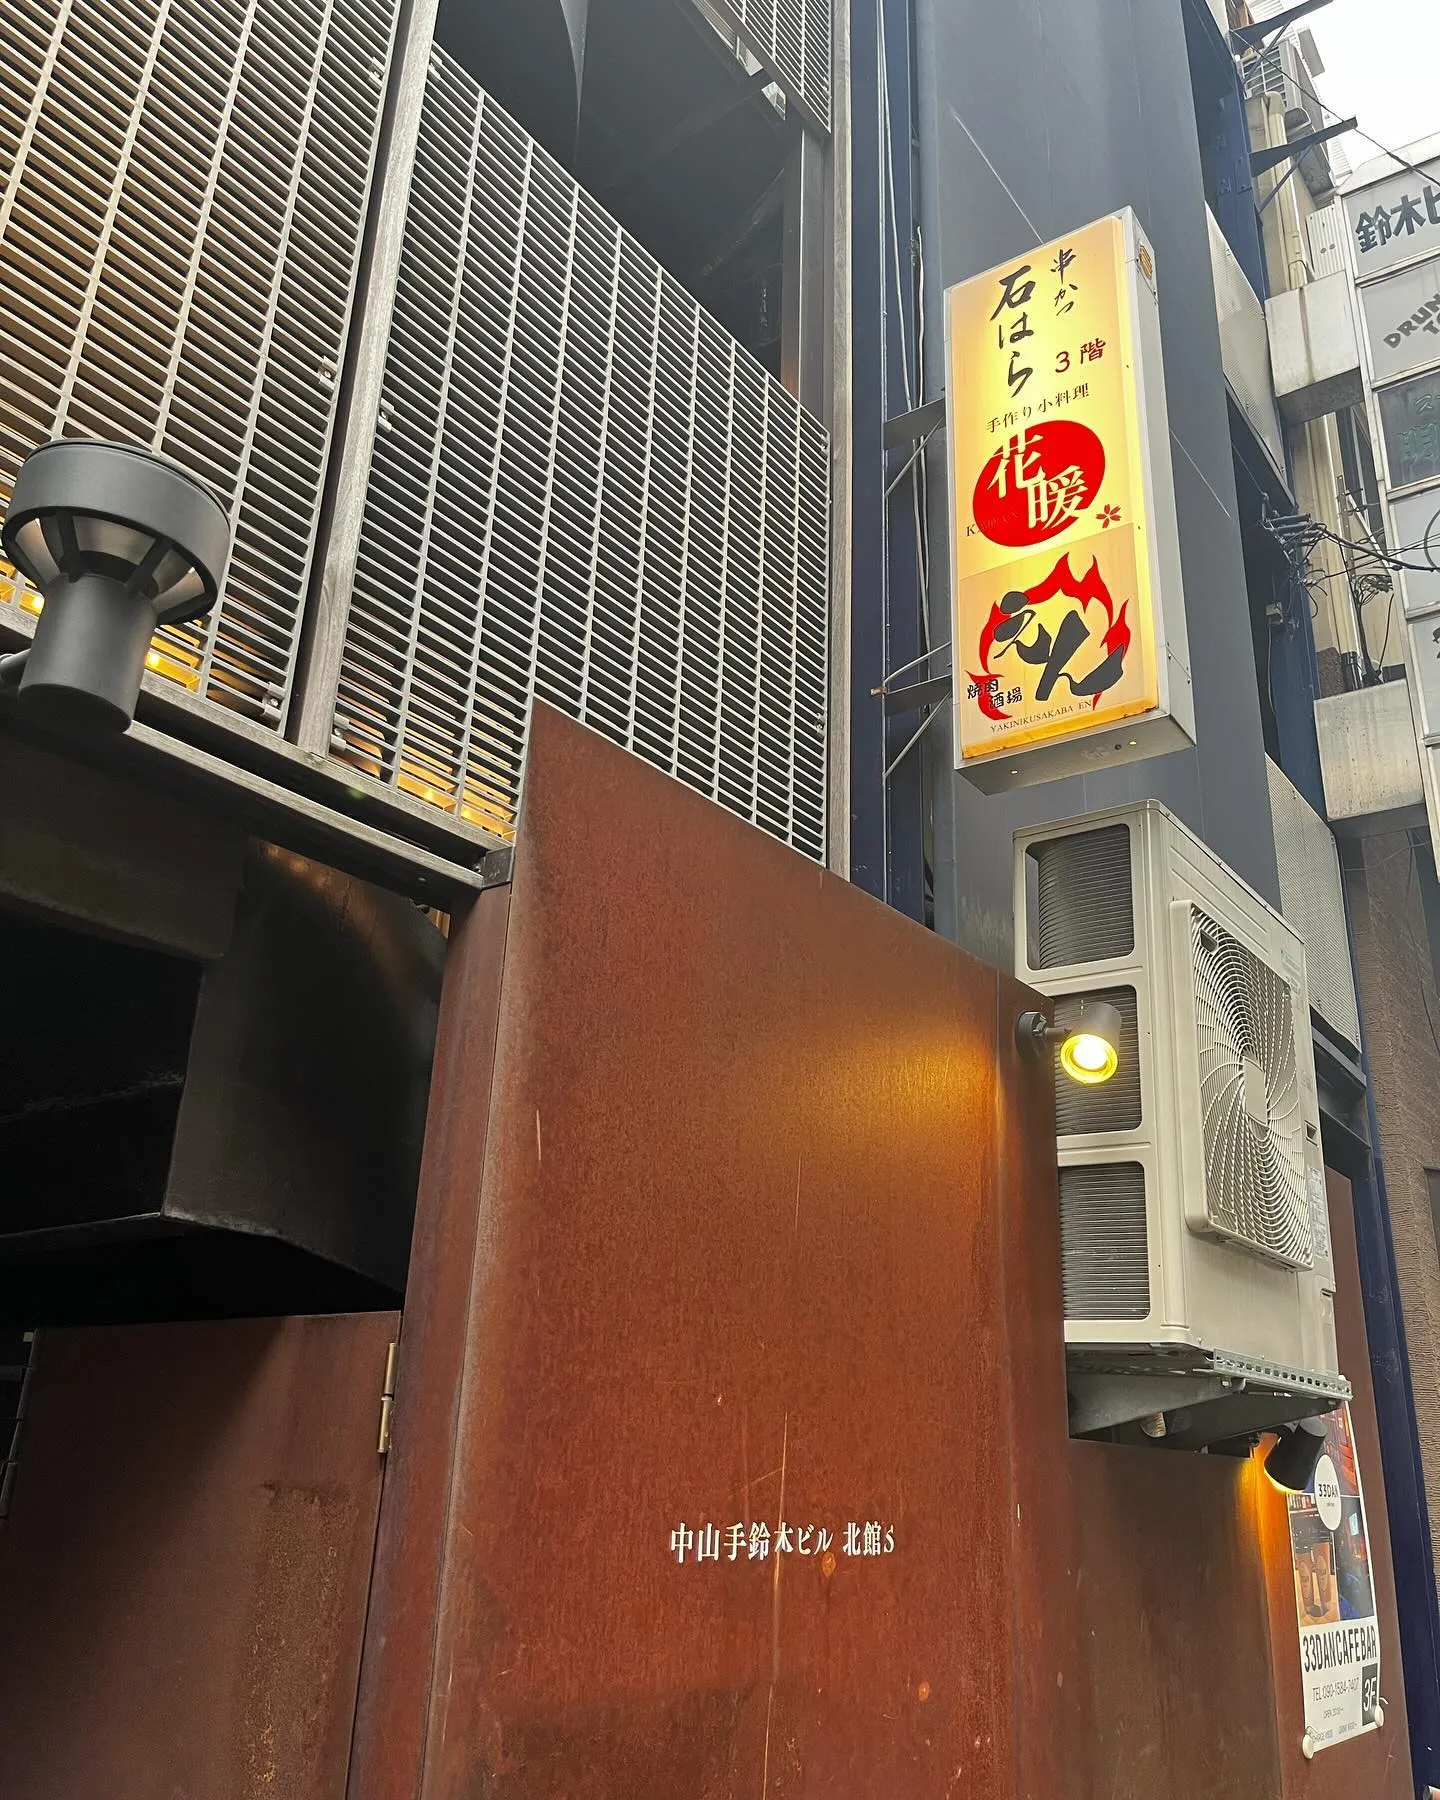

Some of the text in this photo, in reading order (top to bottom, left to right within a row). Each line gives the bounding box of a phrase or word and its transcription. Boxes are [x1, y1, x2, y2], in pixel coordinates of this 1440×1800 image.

[1050, 249, 1078, 316] 串かつ
[990, 265, 1036, 398] 石はら
[986, 382, 1090, 433] 手作り小料理
[986, 428, 1089, 531] 花暖
[993, 591, 1125, 701] えん
[990, 686, 1023, 709] 酒場
[990, 700, 1092, 733] YAKINIKUSAKABA EN
[670, 1521, 834, 1564] 中山手鈴木ビル
[1303, 1625, 1377, 1672] 33DANCAFEBAR
[1363, 1676, 1377, 1712] 3F
